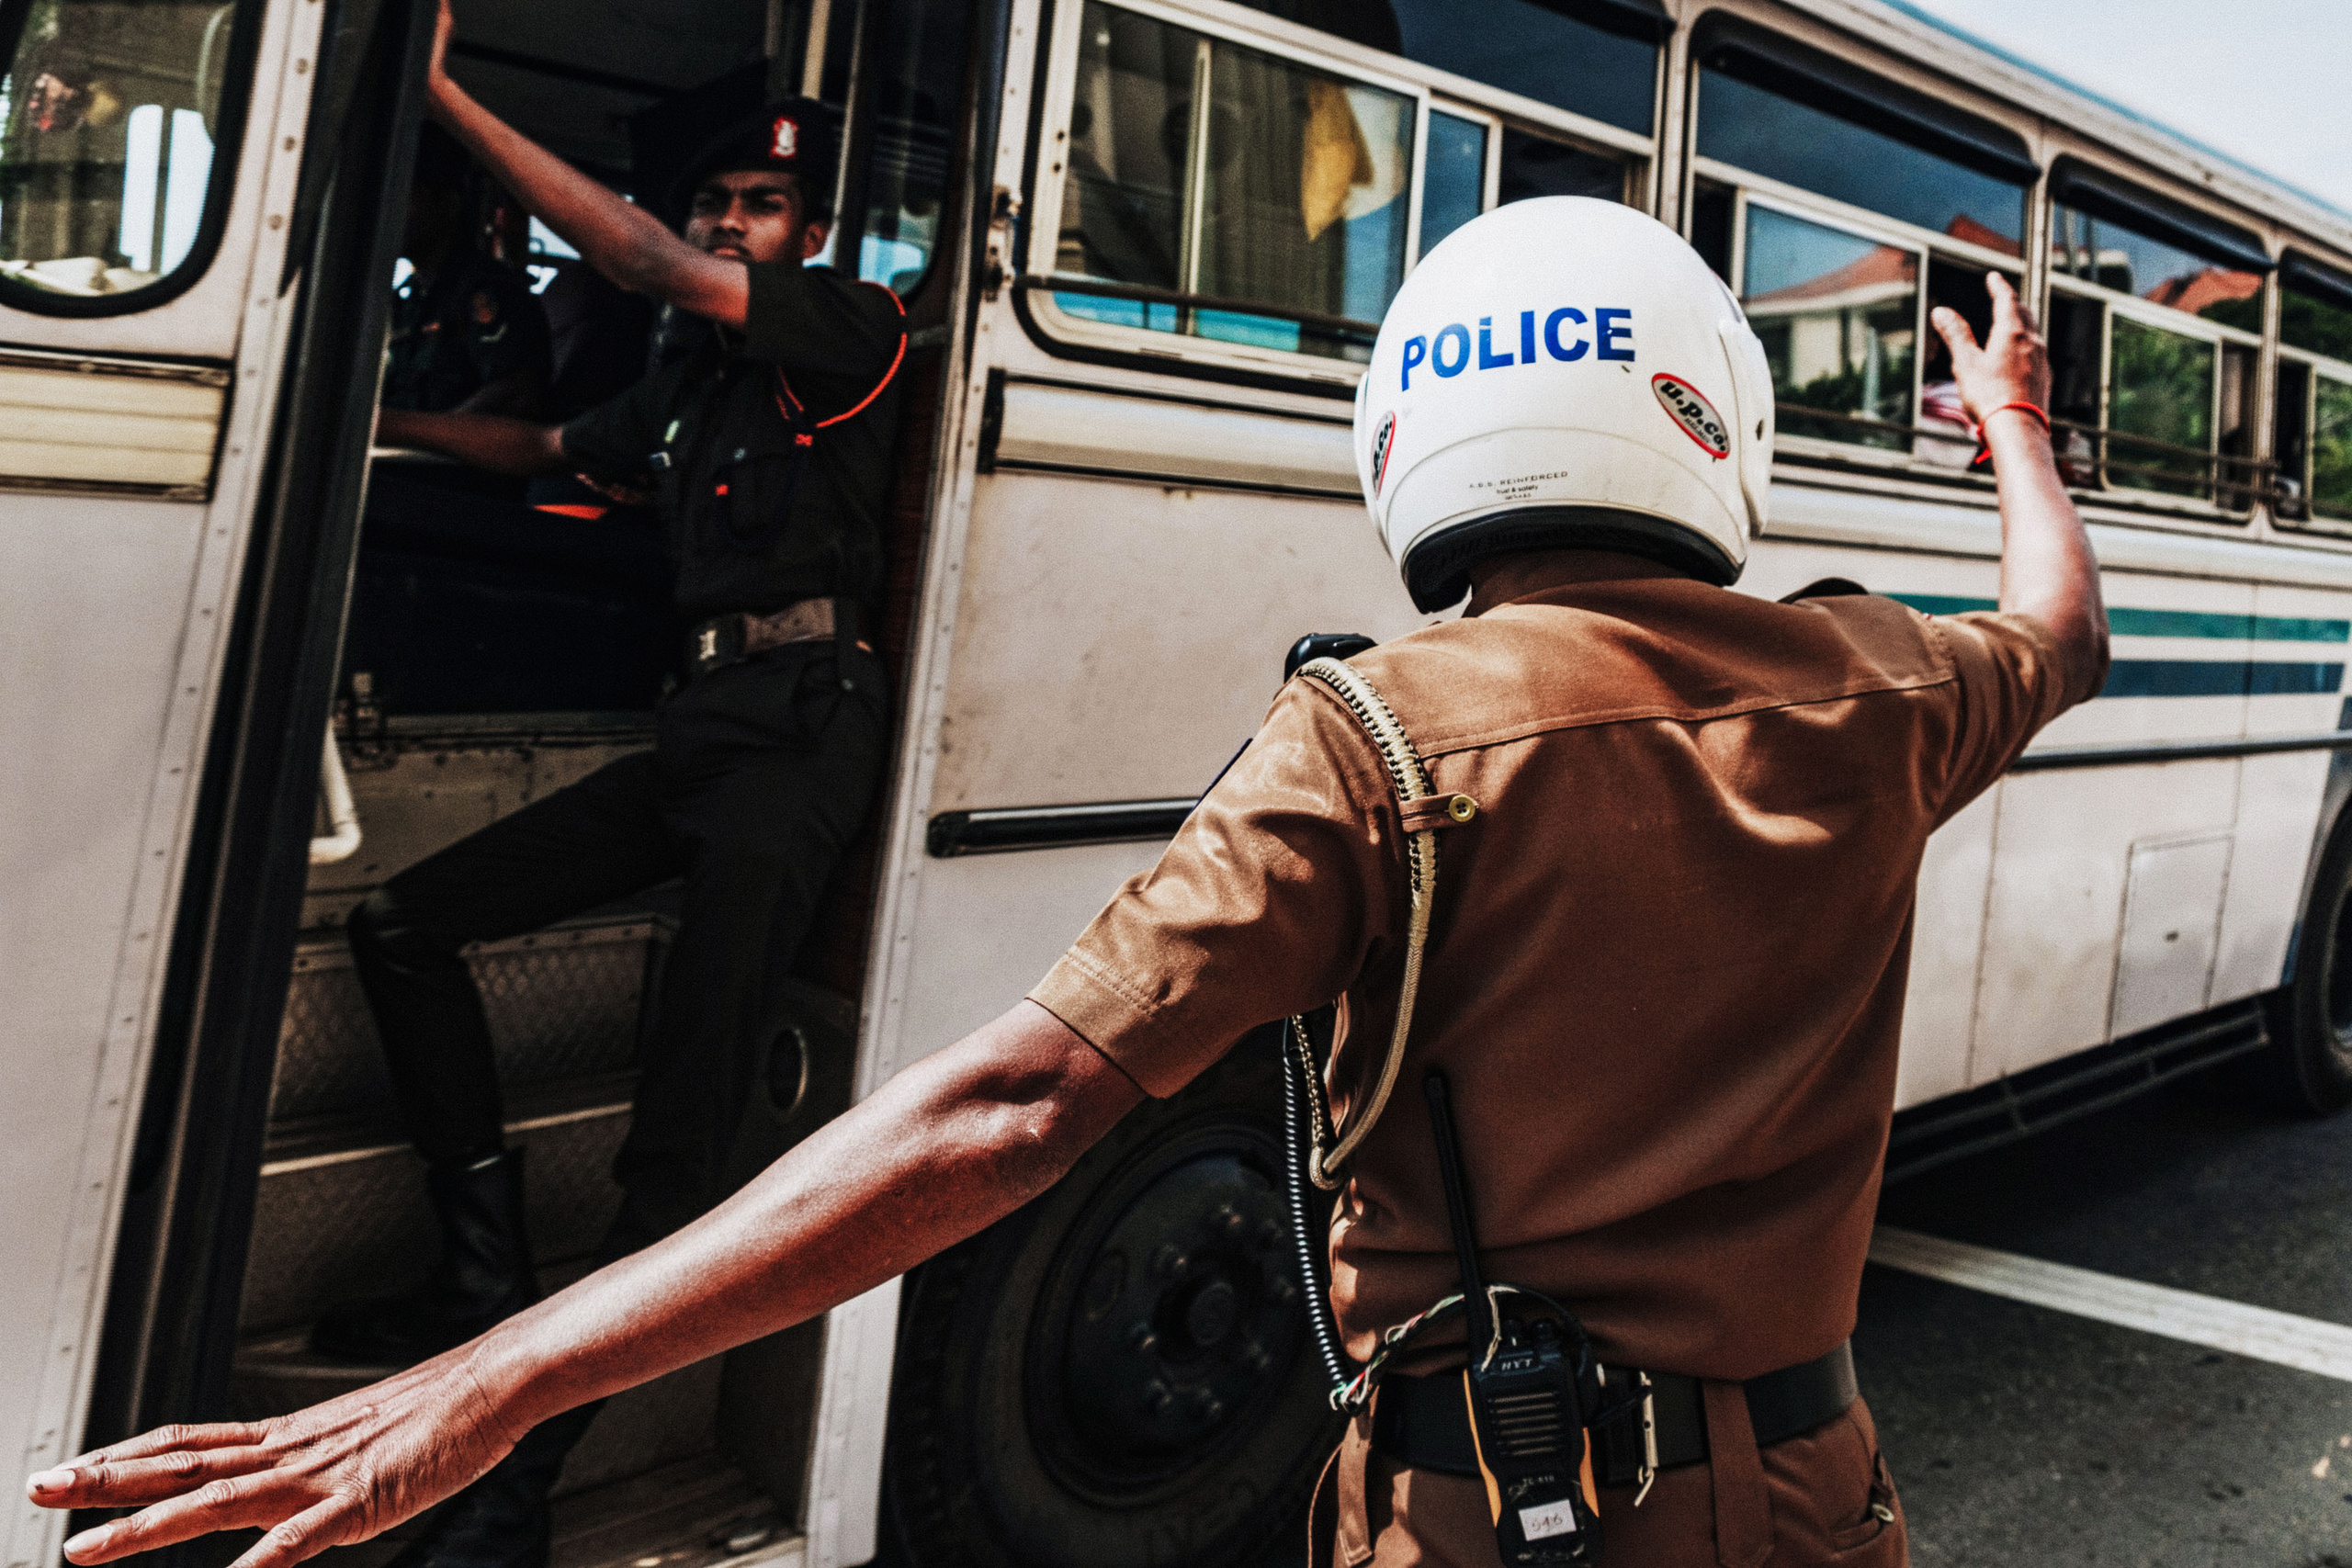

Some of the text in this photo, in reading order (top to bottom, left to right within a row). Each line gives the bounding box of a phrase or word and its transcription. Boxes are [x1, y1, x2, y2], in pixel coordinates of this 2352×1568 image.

[1401, 307, 1635, 392] POLICE
[1500, 470, 1568, 486] REINFORCED
[1502, 1359, 1532, 1371] HYT
